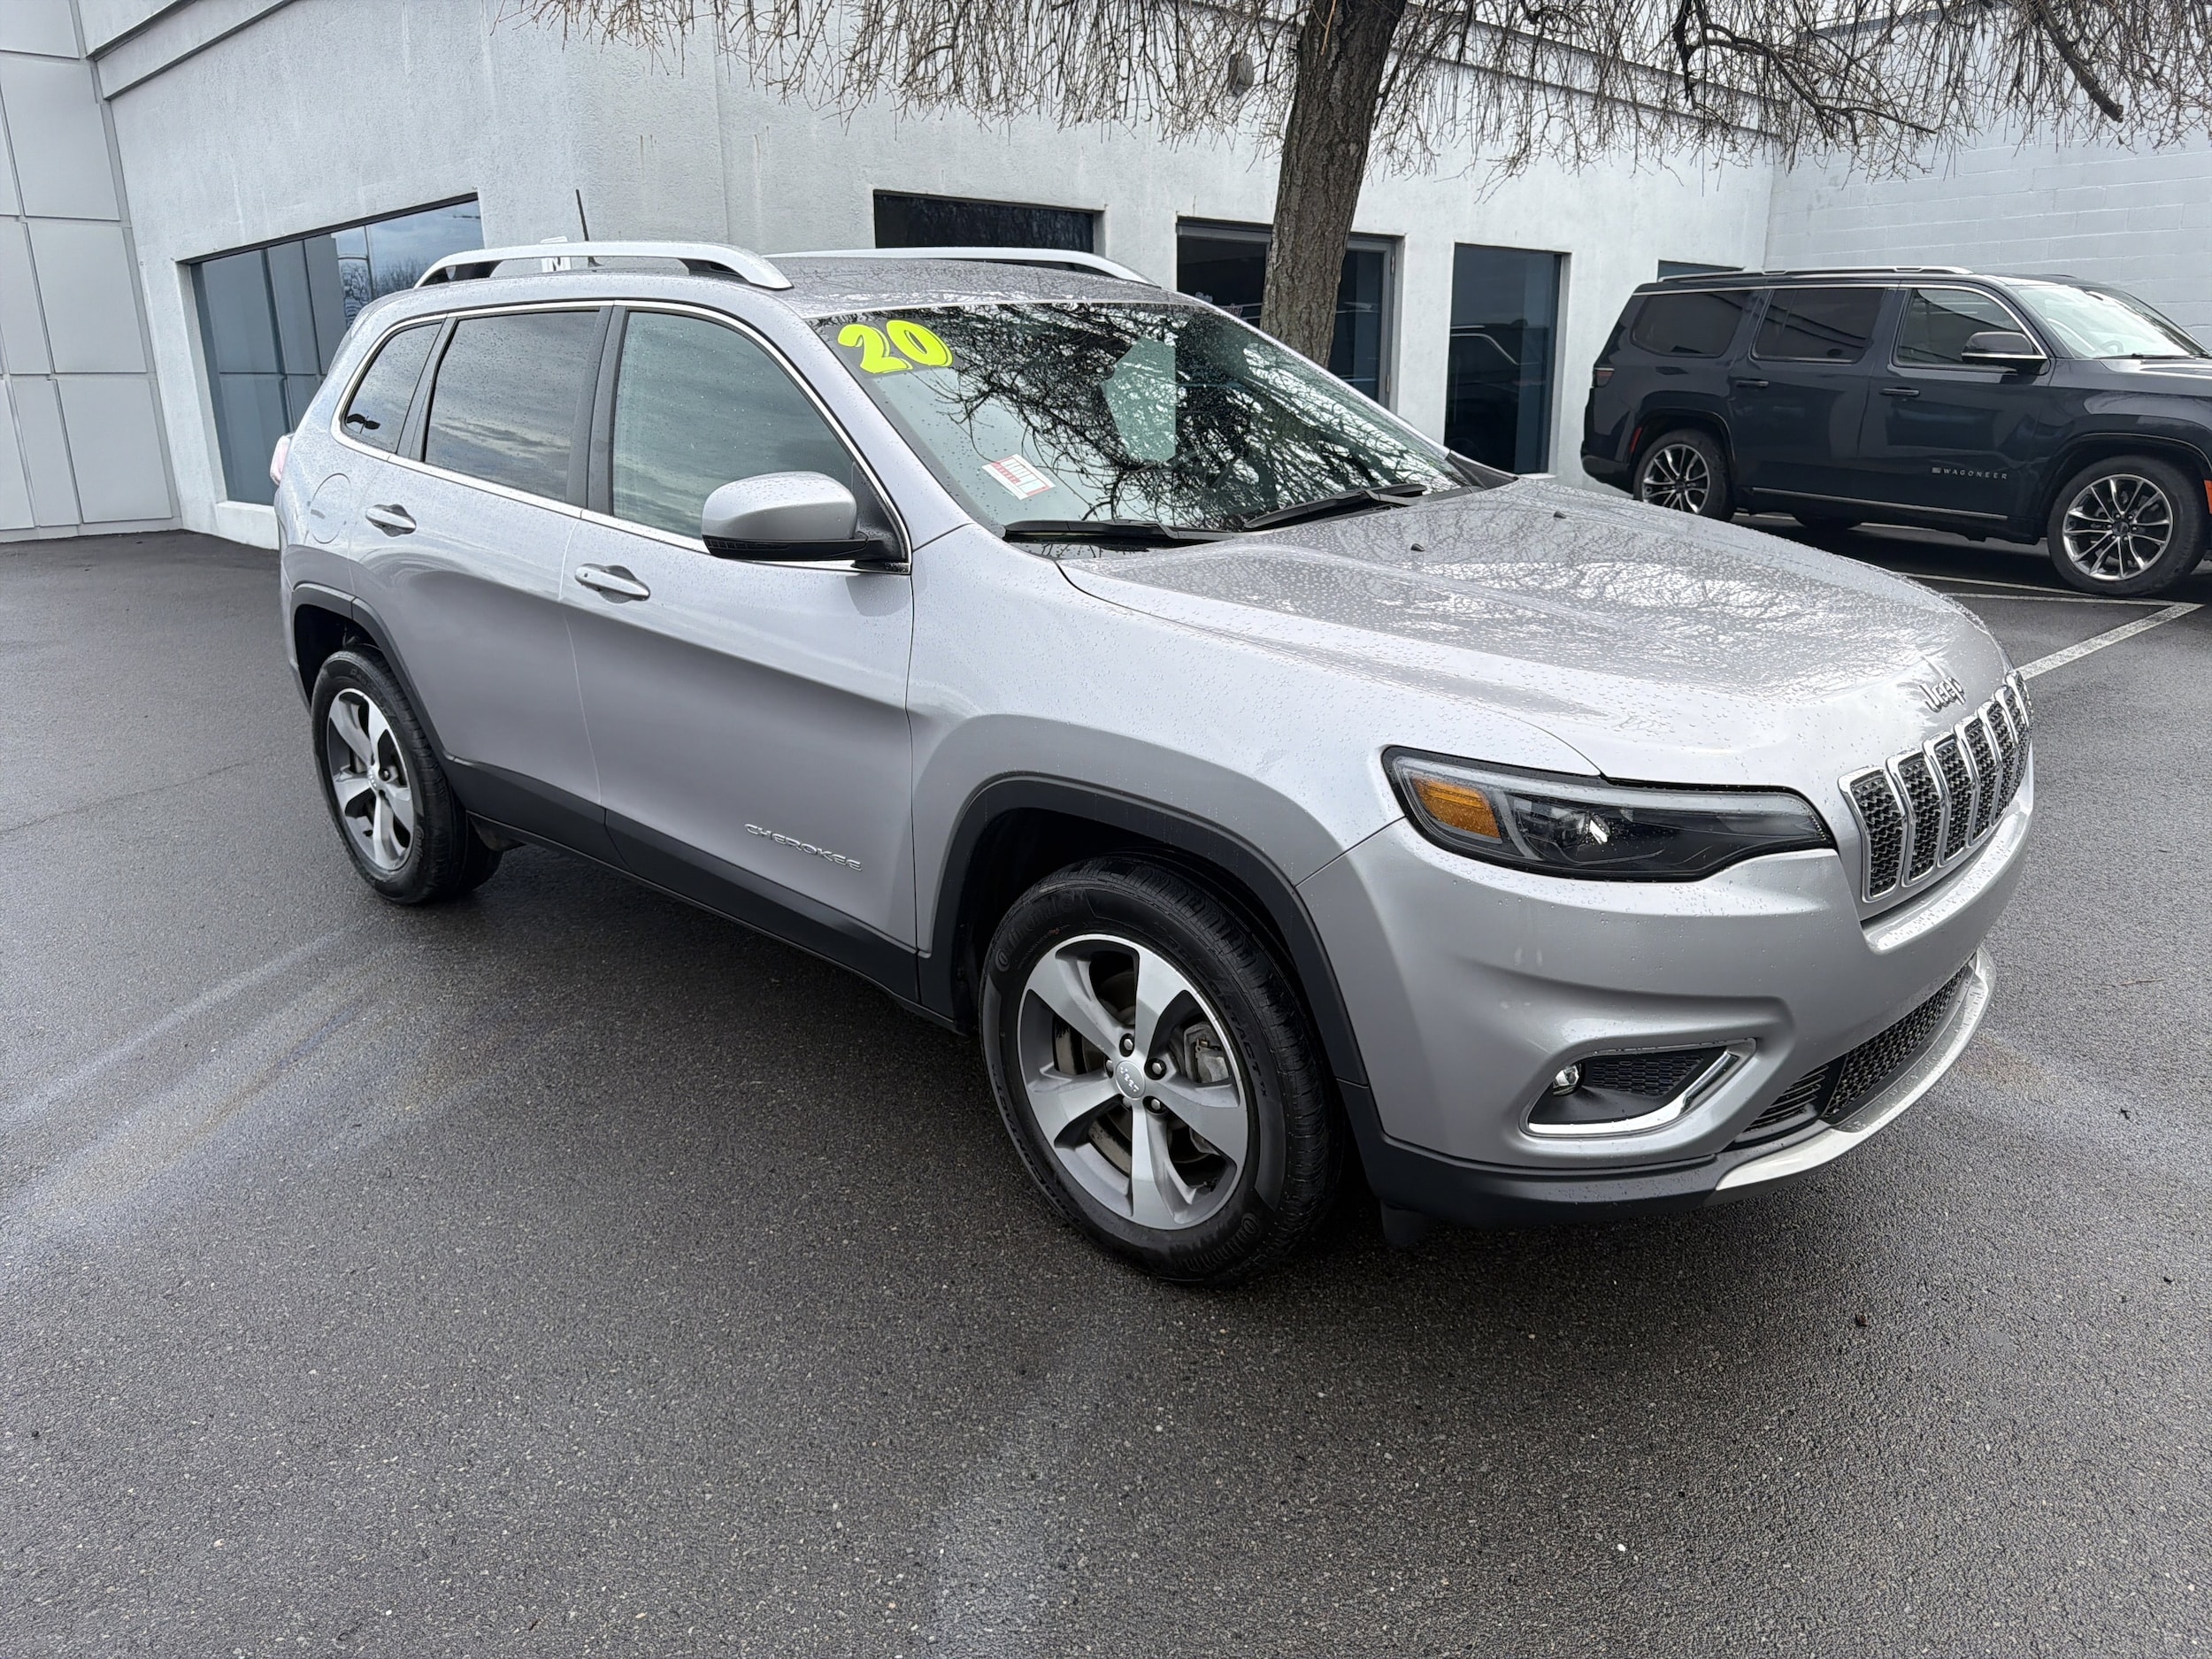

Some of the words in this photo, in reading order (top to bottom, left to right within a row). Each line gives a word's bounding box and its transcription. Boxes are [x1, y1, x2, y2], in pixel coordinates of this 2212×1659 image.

[838, 319, 954, 374] 20
[1943, 467, 2008, 480] WAGONEER
[1919, 676, 1966, 713] Jeep
[744, 823, 862, 872] CHEROKEE
